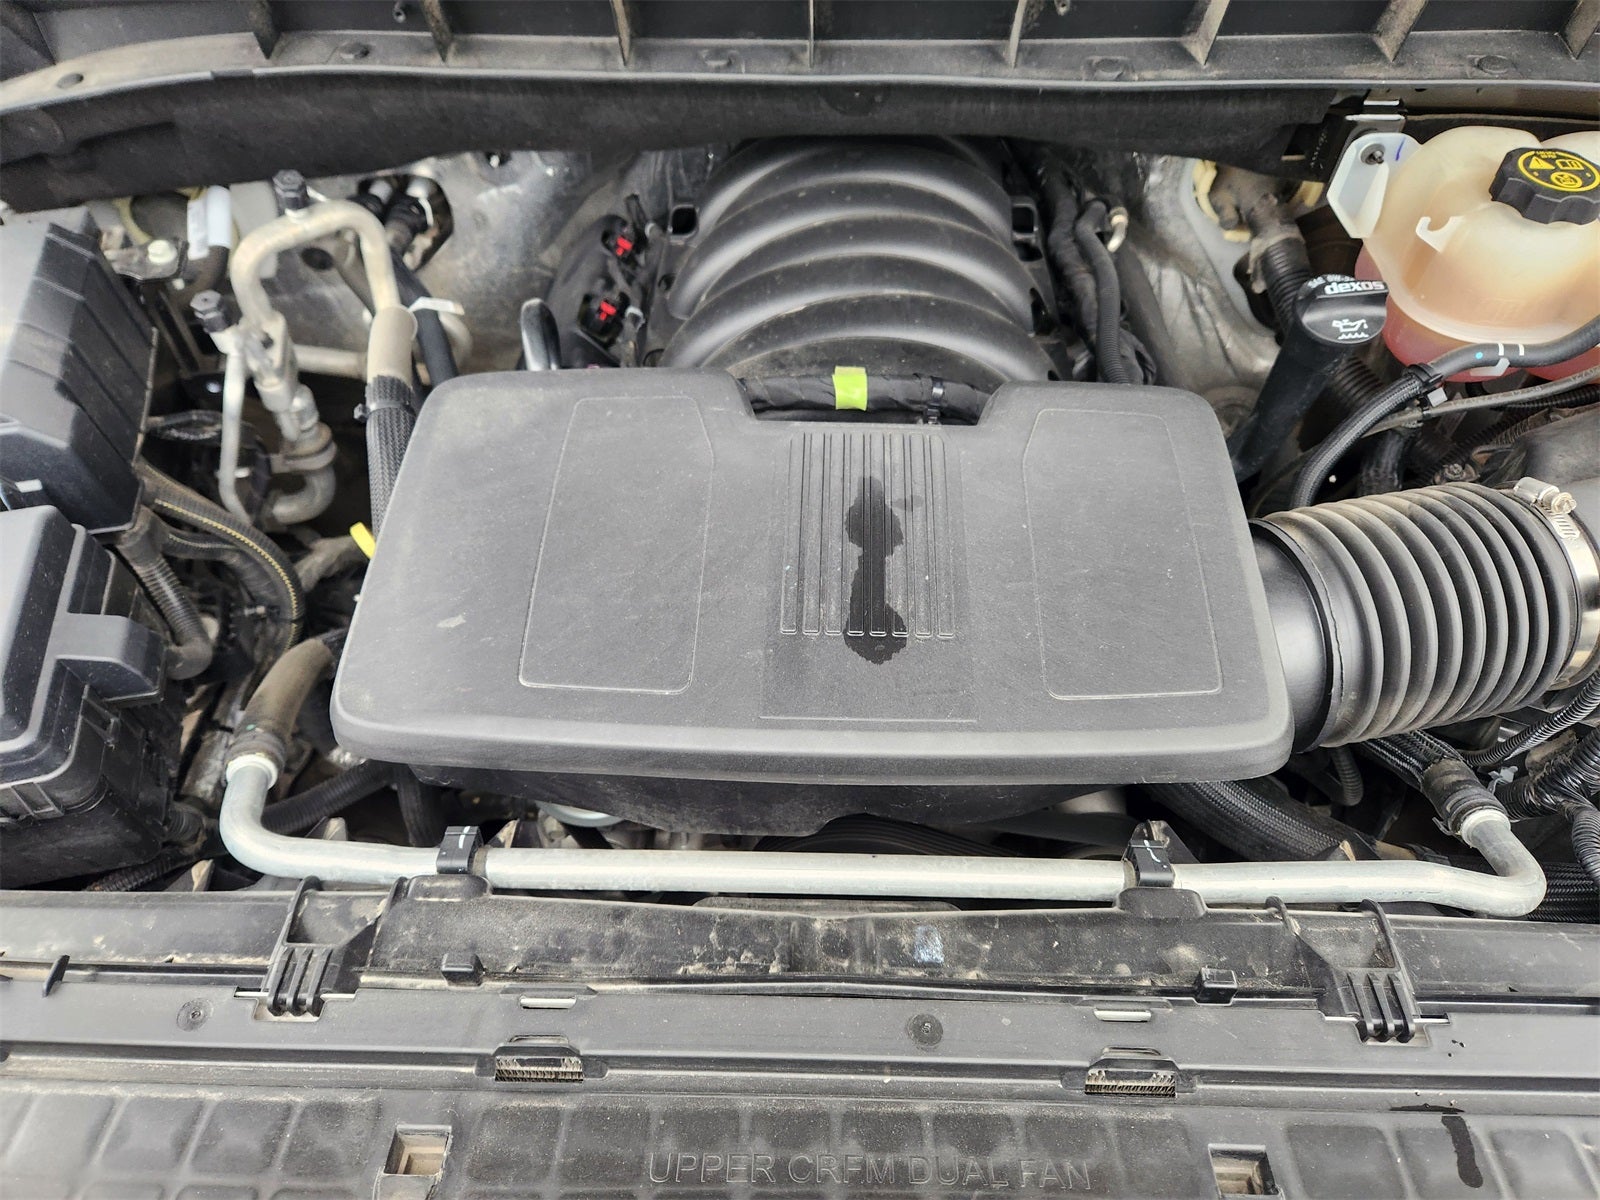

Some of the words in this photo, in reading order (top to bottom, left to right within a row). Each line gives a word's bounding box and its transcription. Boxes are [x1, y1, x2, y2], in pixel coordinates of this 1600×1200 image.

[1324, 281, 1385, 294] dexos
[650, 1152, 776, 1184] UPPER
[788, 1154, 895, 1184] CRFM
[908, 1155, 1009, 1187] DUAL
[1019, 1158, 1091, 1190] FAN
